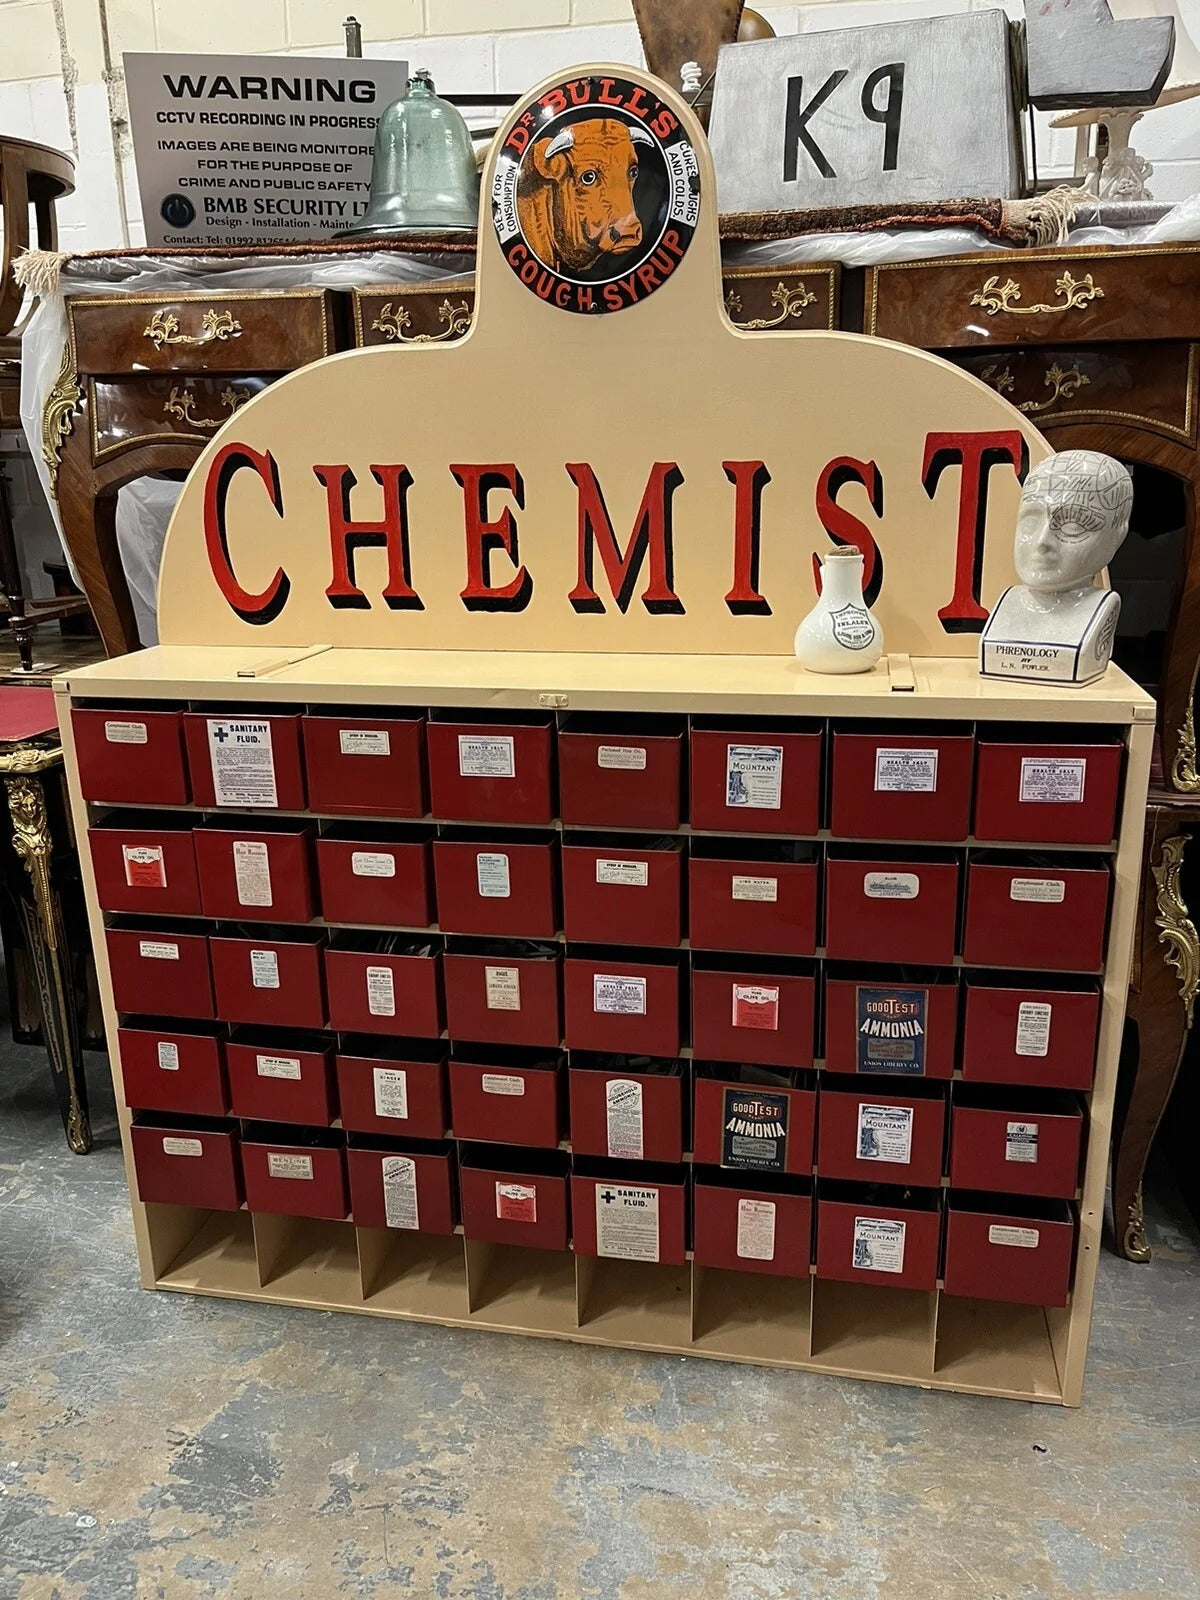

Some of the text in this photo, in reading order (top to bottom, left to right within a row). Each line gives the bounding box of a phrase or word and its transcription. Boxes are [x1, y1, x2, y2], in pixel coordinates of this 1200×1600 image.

[163, 74, 376, 103] WARNING
[156, 111, 195, 124] CCTV
[199, 112, 286, 126] RECORDING
[290, 114, 305, 126] IN
[539, 79, 679, 139] BULL'S
[157, 140, 375, 156] IMAGES ARE BEING MONITORE
[197, 159, 353, 173] FOR THE PURPOSE OF
[669, 152, 684, 176] AND
[178, 177, 372, 192] CRIME AND PUBLIC SAFETY
[494, 174, 504, 196] FOR
[204, 197, 370, 217] BMB SECURITY LT
[504, 165, 516, 232] CONSUMPTION
[686, 183, 698, 222] UGHS
[206, 216, 242, 229] Design
[252, 217, 310, 229] Installation
[163, 235, 204, 244] Contact:
[206, 236, 223, 244] Tel:
[508, 230, 685, 311] COUGH SYRUP
[203, 430, 1029, 635] CHEMIST
[995, 645, 1060, 659] PHRENOLOGY
[229, 724, 268, 733] SANITARY
[860, 1017, 924, 1038] AMMONIA
[725, 1117, 786, 1138] AMMONIA
[618, 1189, 656, 1199] SANITARY
